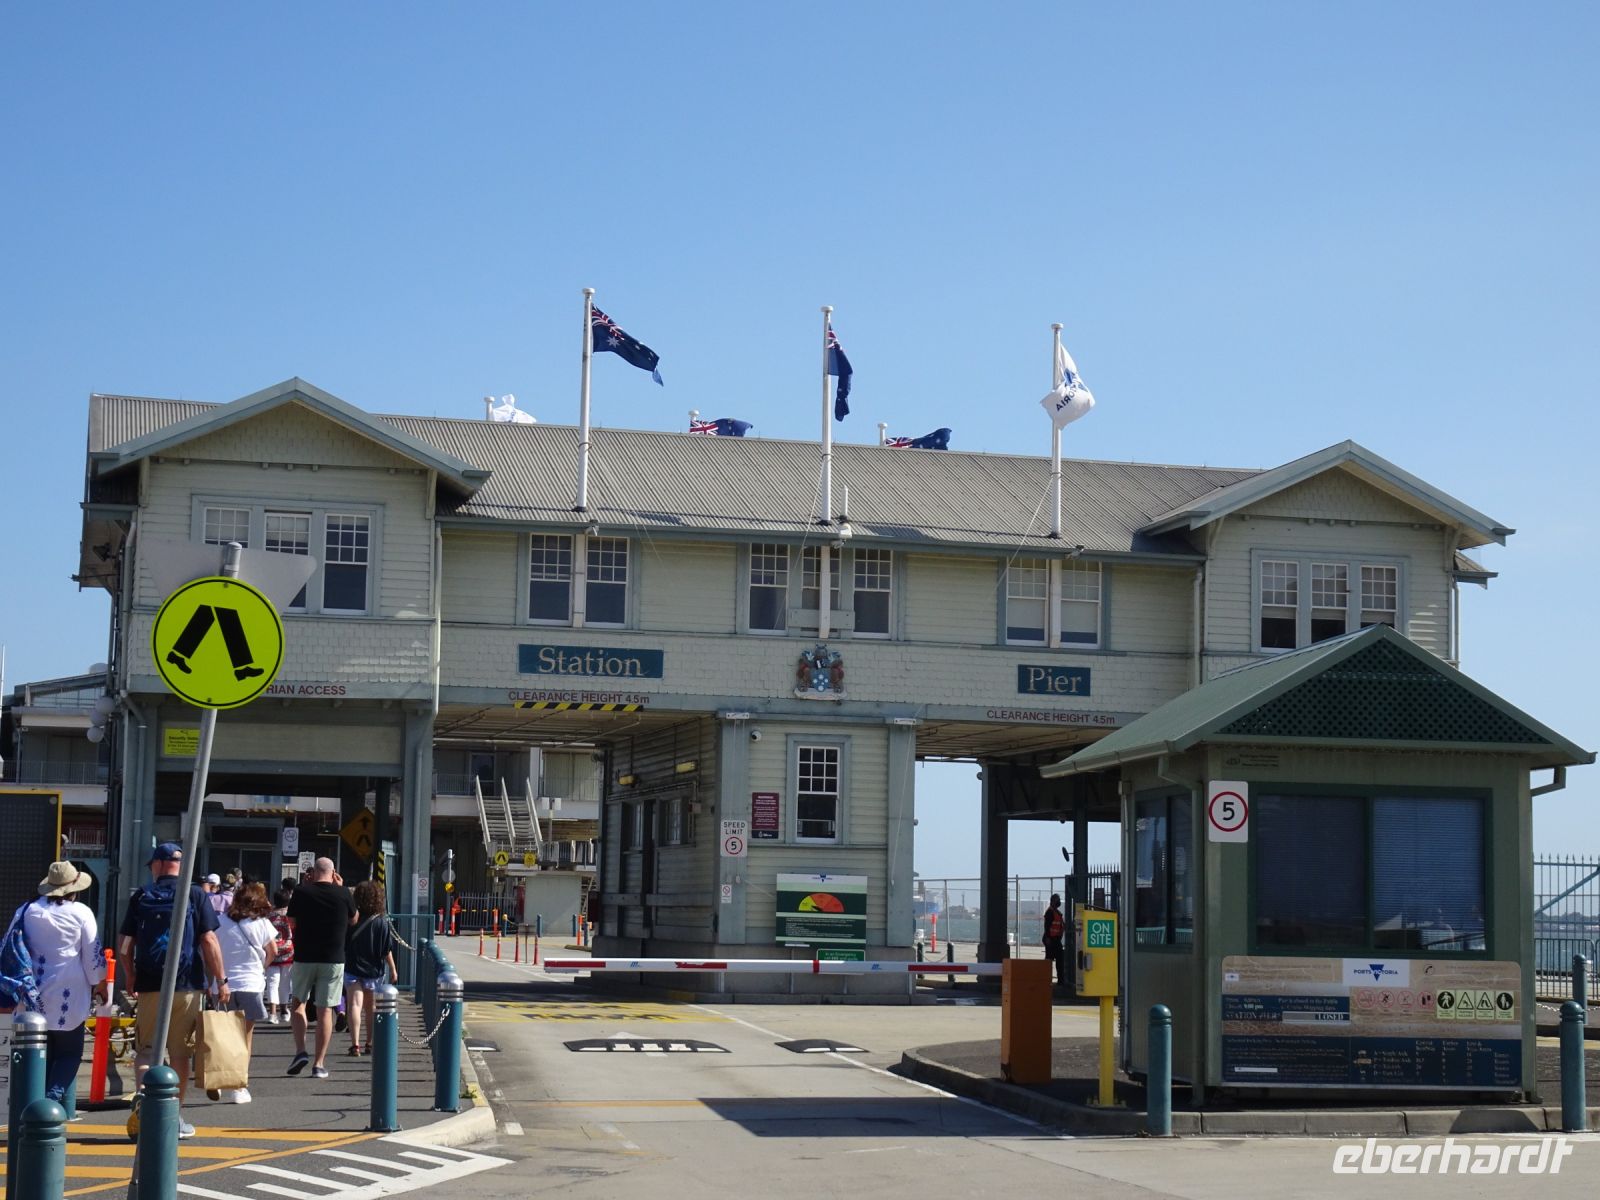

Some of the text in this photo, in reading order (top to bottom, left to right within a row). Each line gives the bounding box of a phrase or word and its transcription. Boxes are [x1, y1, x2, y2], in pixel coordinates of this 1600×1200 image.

[537, 647, 645, 677] Station
[1027, 667, 1082, 694] Pier
[298, 685, 346, 696] ACCESS
[508, 691, 650, 704] CLEARANCE HEIGHT 4.5m
[986, 709, 1051, 722] CLEARANCE
[1052, 712, 1091, 723] HEIGHT
[1222, 801, 1235, 821] 5
[723, 821, 746, 829] SPEED
[730, 841, 738, 850] 5
[1092, 922, 1110, 934] ON
[1090, 933, 1112, 945] SITE
